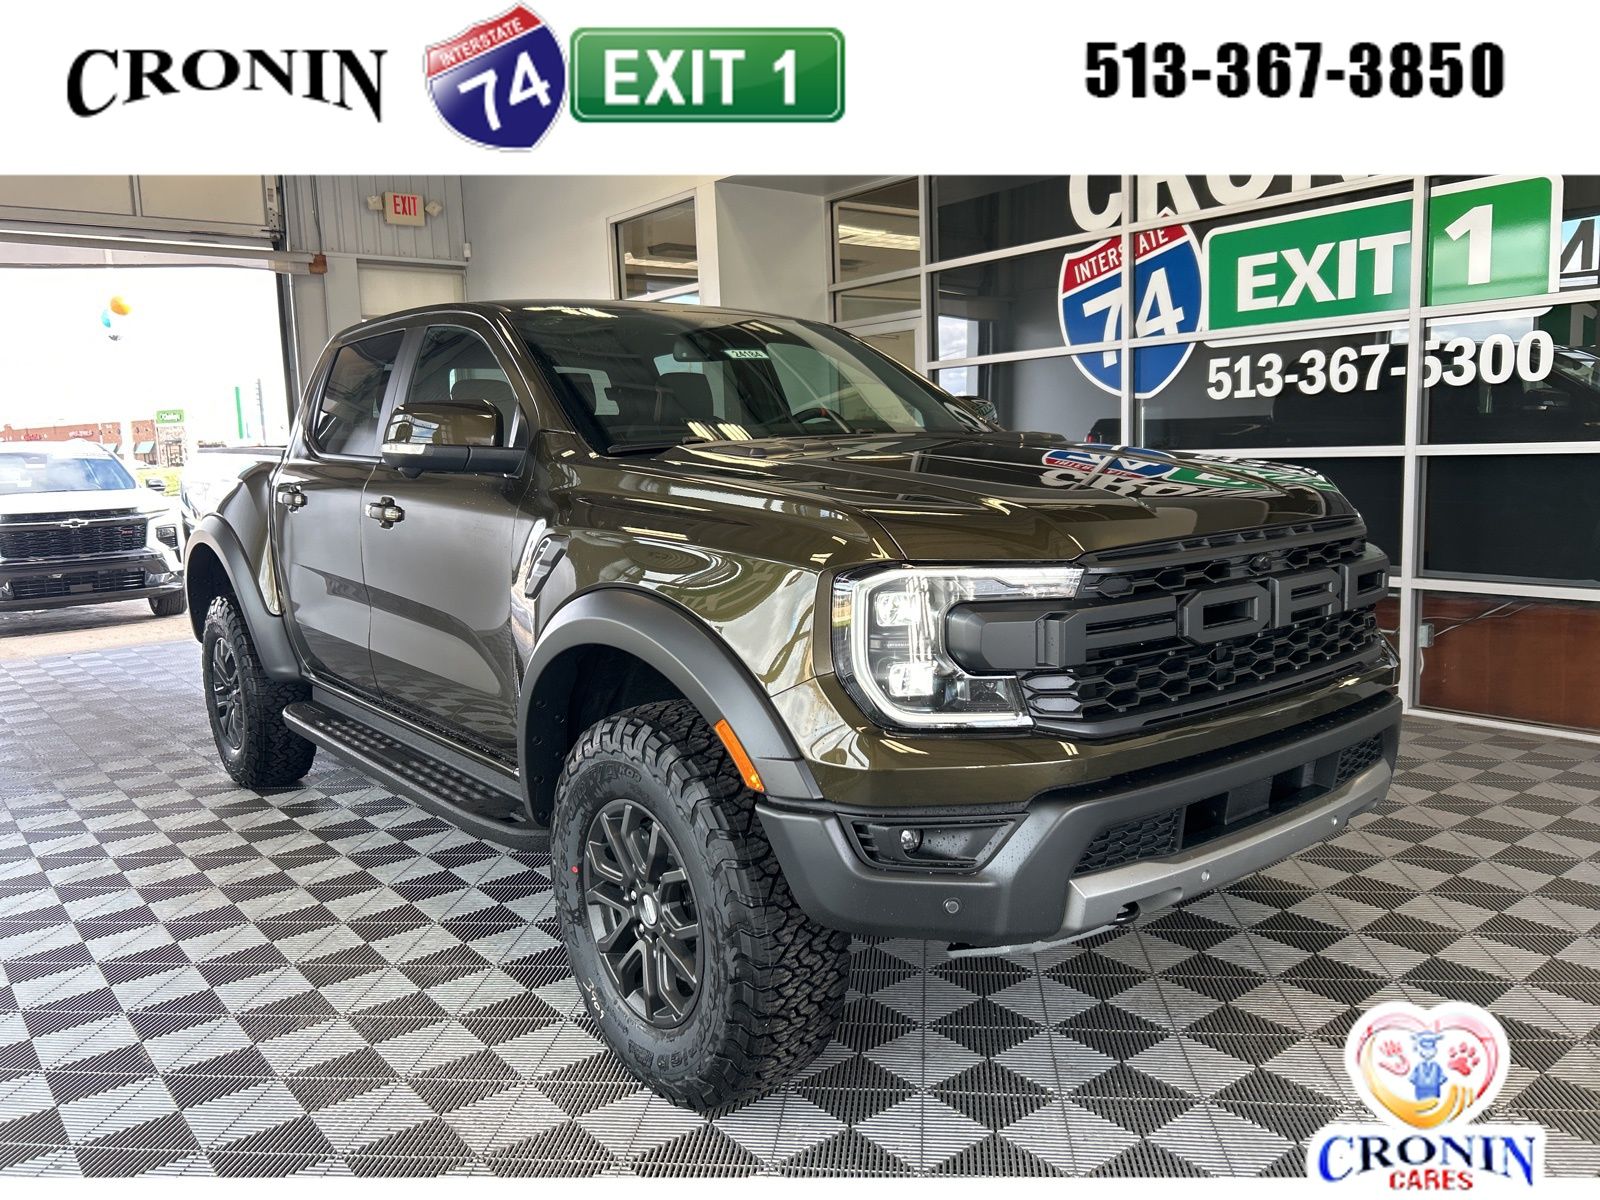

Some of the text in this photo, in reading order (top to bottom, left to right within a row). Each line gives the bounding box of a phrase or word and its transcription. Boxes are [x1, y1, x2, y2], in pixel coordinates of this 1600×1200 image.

[392, 194, 418, 217] EXIT
[1073, 229, 1169, 285] INTERATE
[1237, 230, 1411, 313] EXIT
[1444, 203, 1494, 286] 1
[1082, 268, 1185, 369] 74
[1206, 330, 1555, 400] 513-367-5300
[1062, 557, 1389, 669] FORD
